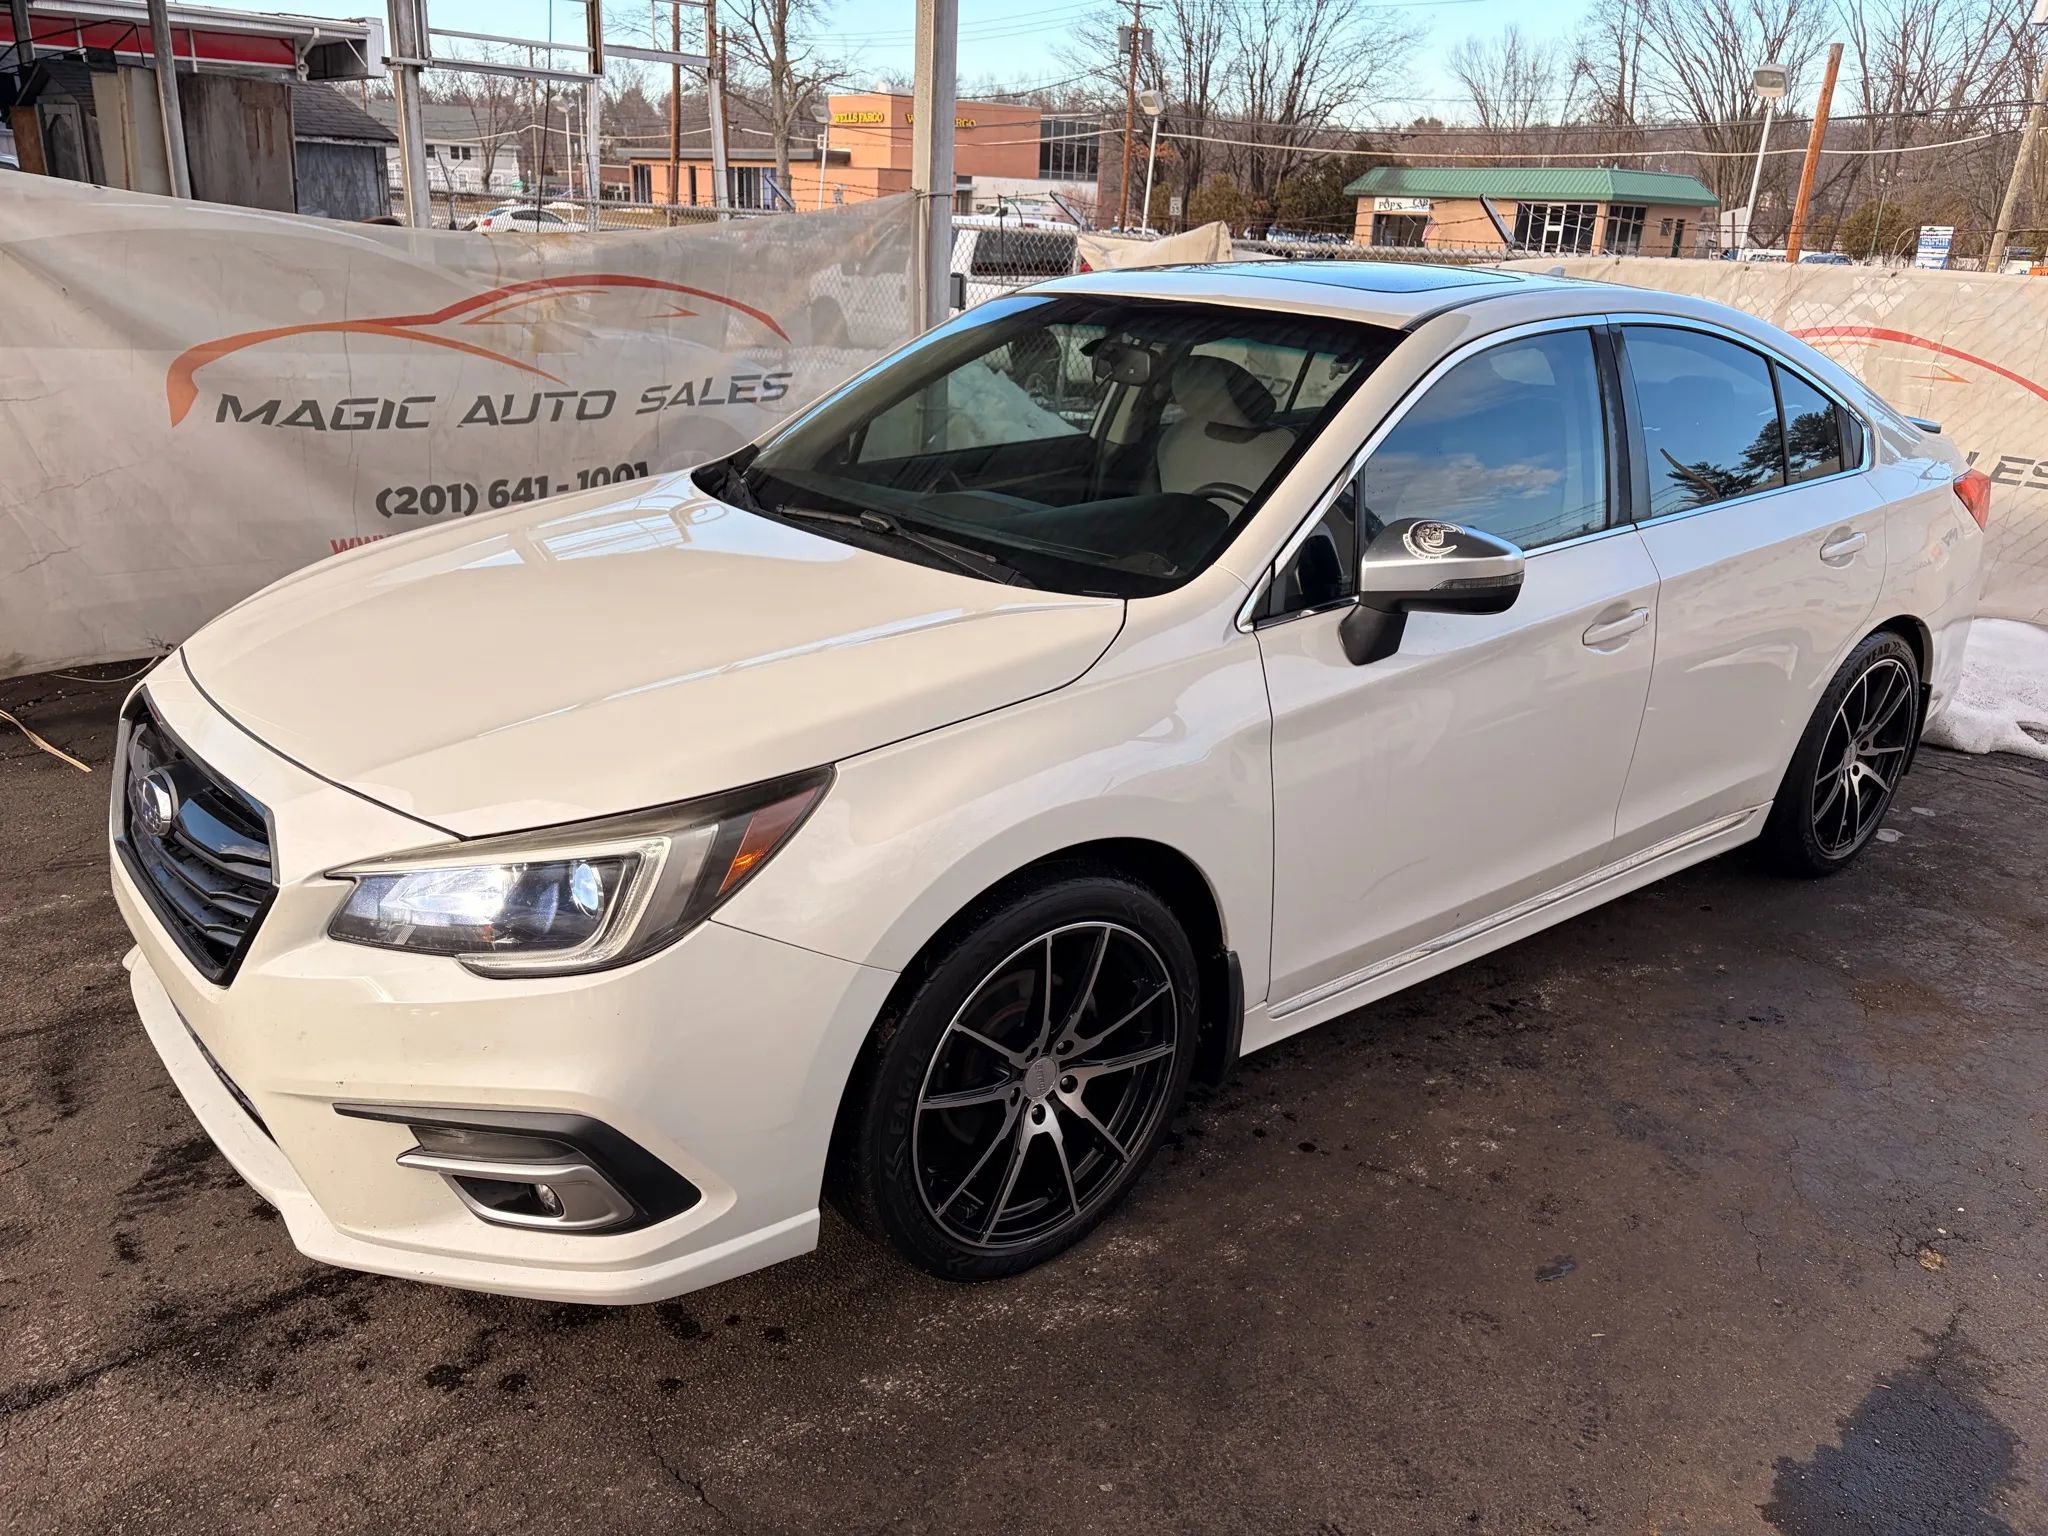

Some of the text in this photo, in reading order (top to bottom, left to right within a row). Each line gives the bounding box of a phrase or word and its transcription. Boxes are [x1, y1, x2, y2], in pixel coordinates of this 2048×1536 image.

[834, 111, 884, 123] WELLS FARGO
[955, 117, 977, 128] RGO
[215, 372, 793, 431] MAGIC AUTO SALES
[375, 482, 479, 518] (201)
[488, 475, 548, 509] 641
